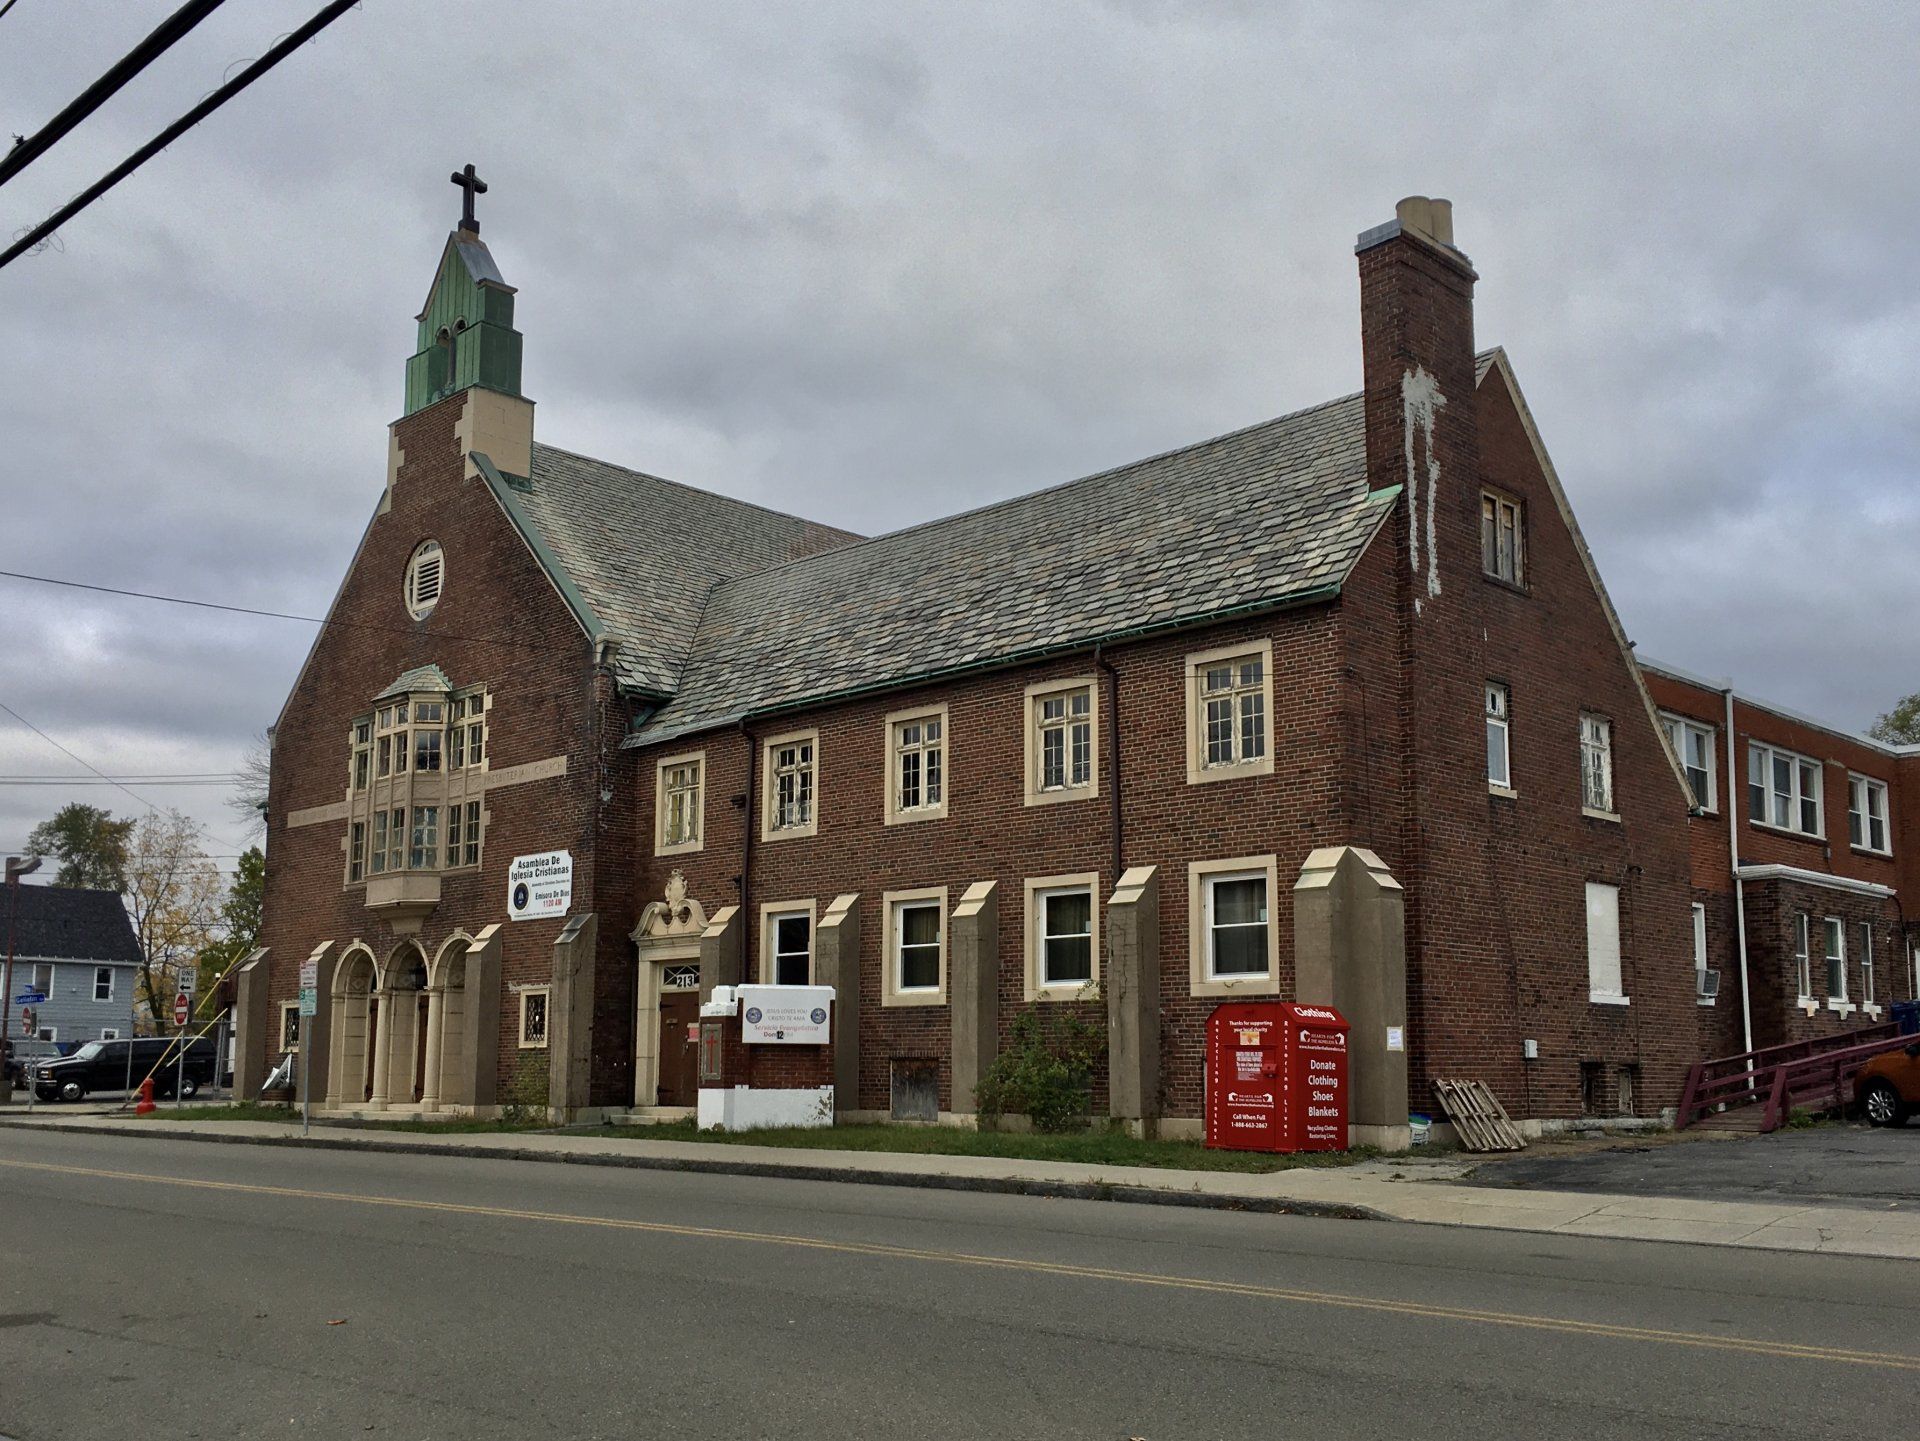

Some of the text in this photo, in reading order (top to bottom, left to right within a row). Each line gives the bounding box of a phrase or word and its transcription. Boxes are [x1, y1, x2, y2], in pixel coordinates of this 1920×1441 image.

[518, 856, 561, 869] Asamblea De
[511, 866, 569, 882] Iglesia Cristianas
[535, 889, 570, 900] Emisora De Dios
[543, 898, 563, 907] 1120 AM
[677, 975, 693, 988] 213
[1293, 1007, 1336, 1021] Clothing
[1310, 1059, 1336, 1070] Donate
[1308, 1075, 1338, 1088] Clothing
[1312, 1091, 1334, 1101] Shoes
[1308, 1106, 1338, 1117] Blankets
[1307, 1124, 1324, 1132] Recycling
